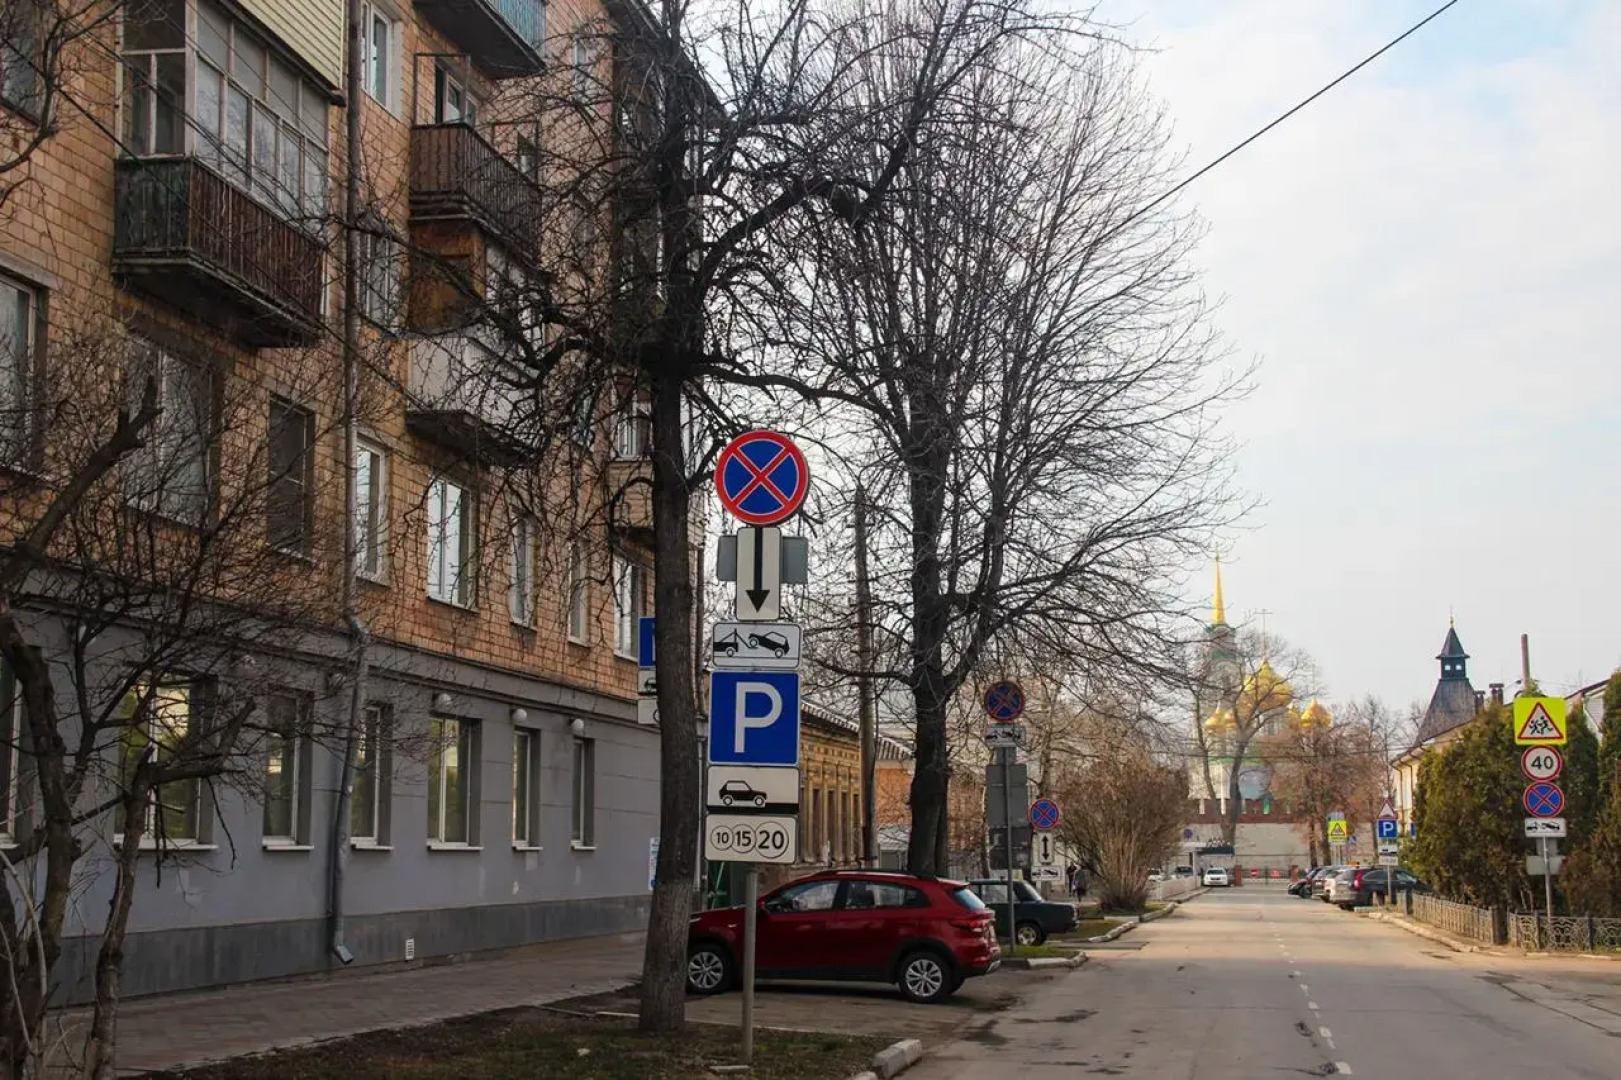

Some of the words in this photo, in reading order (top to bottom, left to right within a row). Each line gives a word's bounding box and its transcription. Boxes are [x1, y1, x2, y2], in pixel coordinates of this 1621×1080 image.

[734, 681, 783, 753] P
[1531, 756, 1554, 770] 40
[1383, 821, 1394, 837] P
[716, 831, 729, 845] 10
[735, 831, 752, 847] 15
[758, 830, 784, 849] 20
